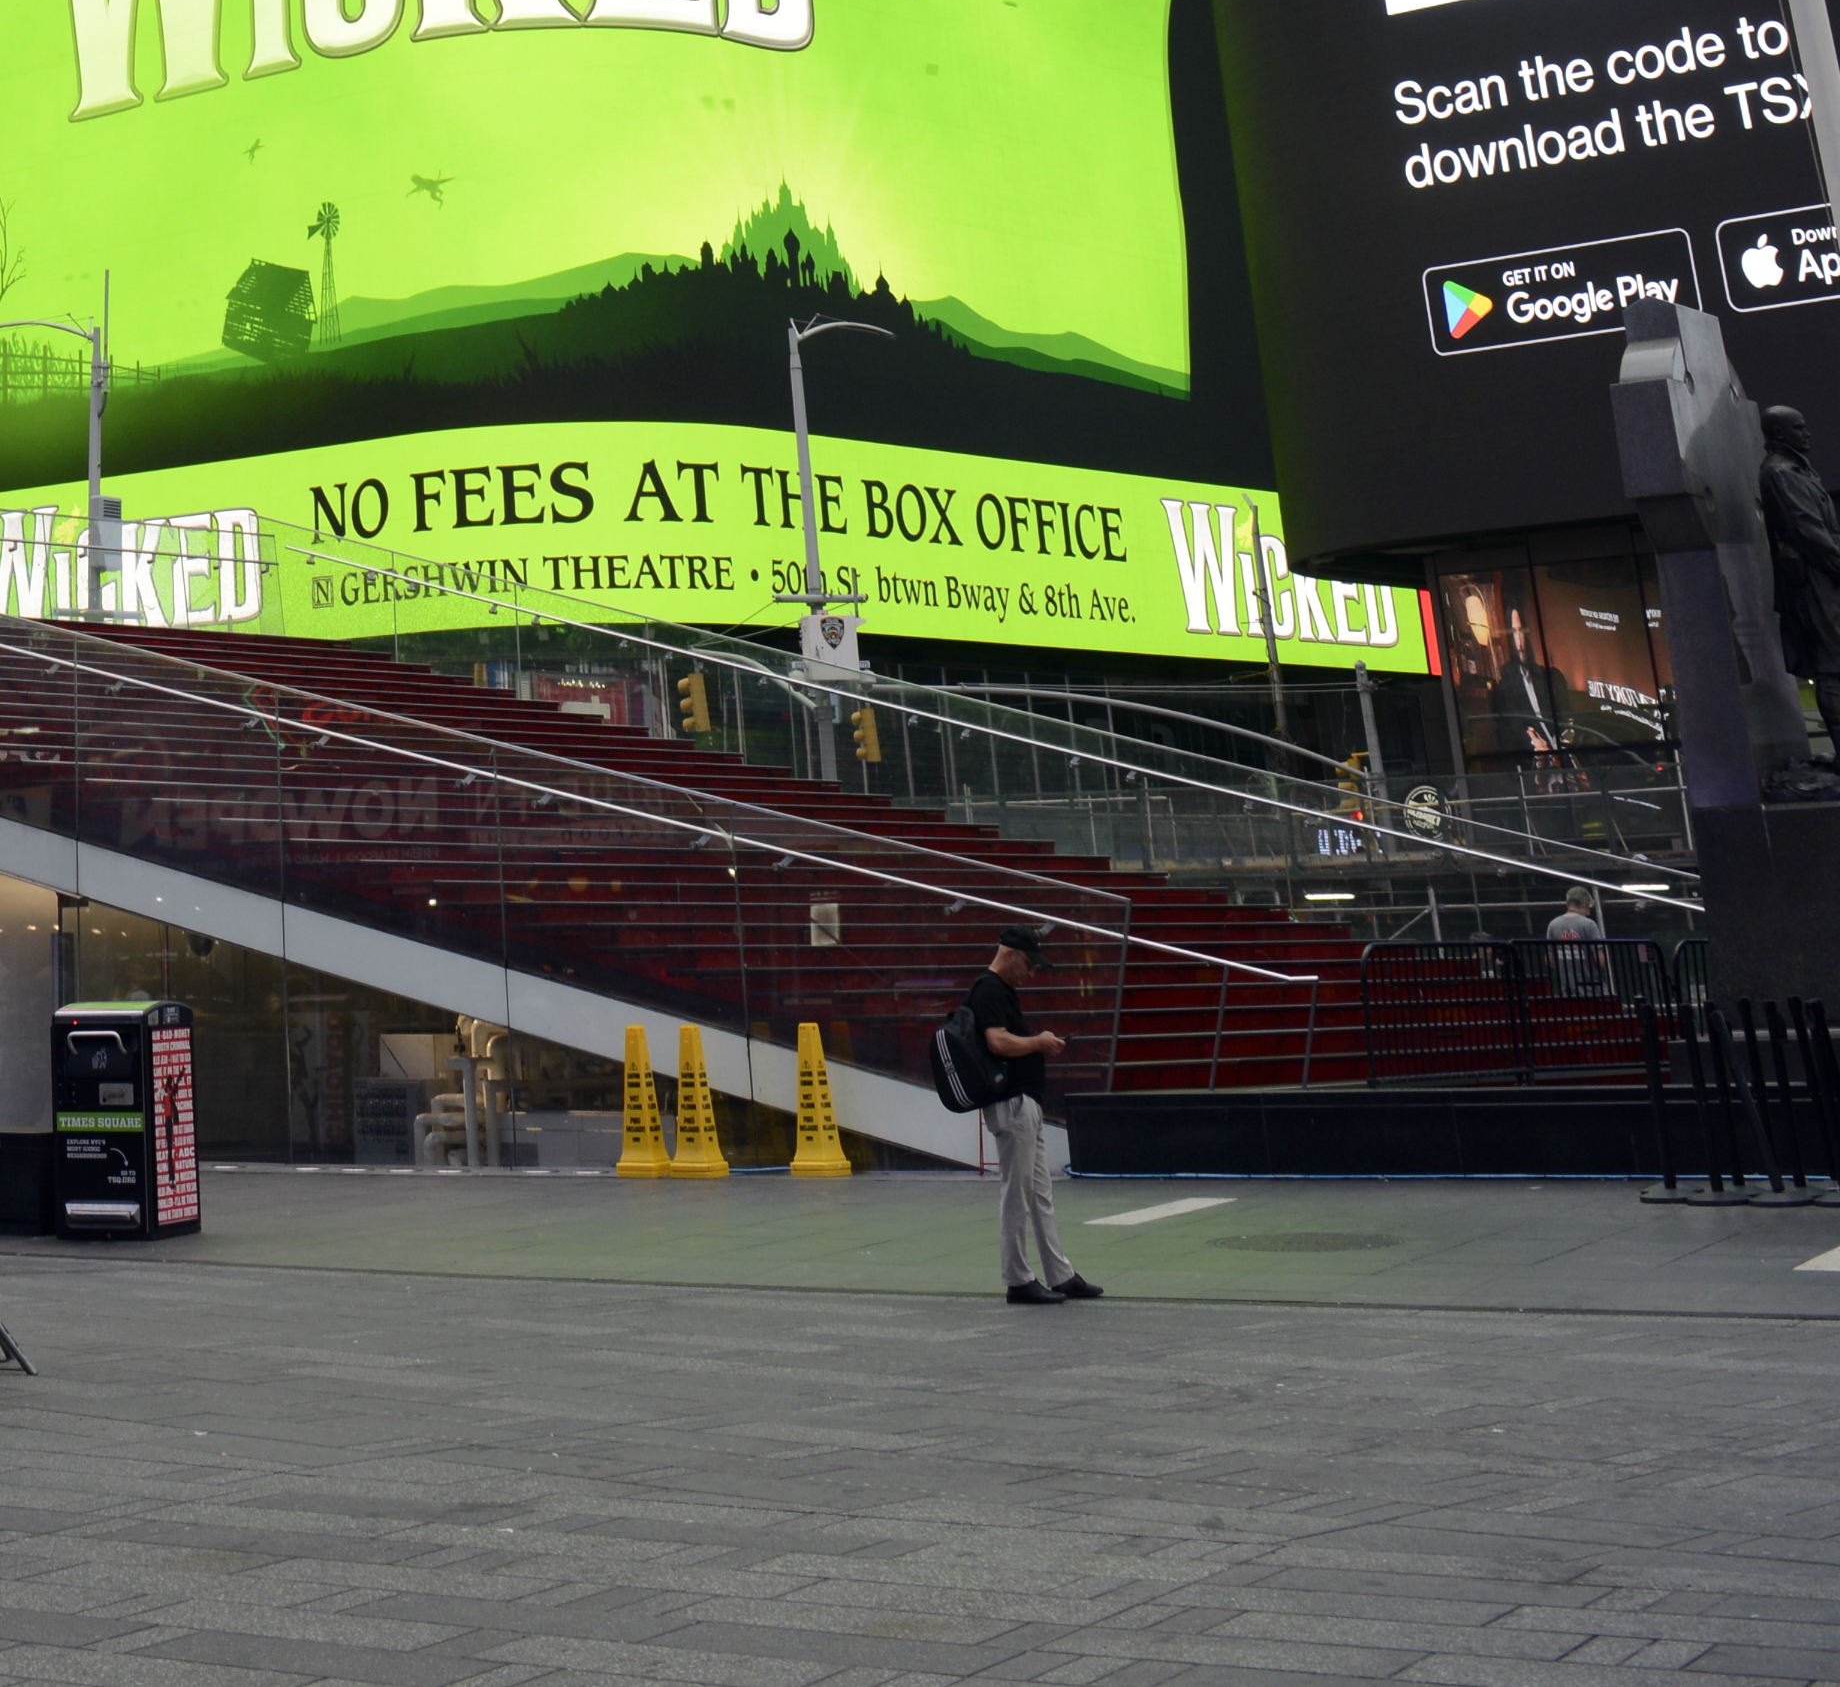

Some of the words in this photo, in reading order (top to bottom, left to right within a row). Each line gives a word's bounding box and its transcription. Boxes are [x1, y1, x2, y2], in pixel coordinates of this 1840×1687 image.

[1393, 68, 1510, 126] Scan
[1519, 55, 1595, 105] the
[1605, 26, 1727, 86] code
[1736, 15, 1790, 61] to
[1403, 108, 1625, 190] download
[1635, 98, 1716, 150] the
[1502, 266, 1535, 288] GET
[1536, 264, 1549, 283] IT
[1550, 260, 1576, 280] ON
[1506, 280, 1614, 329] Google
[1617, 273, 1680, 317] Play
[308, 476, 391, 544] NO
[411, 459, 596, 533] FEES
[623, 458, 720, 525] AT
[738, 462, 849, 535] THE
[863, 476, 965, 548] BOX
[974, 490, 1129, 564] OFFICE
[339, 555, 529, 608] GERSHWIN
[542, 552, 737, 594] THEATRE
[874, 564, 939, 608] btwn
[944, 575, 1012, 624] Bway
[1017, 583, 1041, 616] &
[1045, 584, 1084, 620] 8th
[1086, 586, 1137, 625] Ave.
[59, 1115, 96, 1129] TIMES
[97, 1115, 142, 1129] SQUARE
[178, 1147, 195, 1158] ABC
